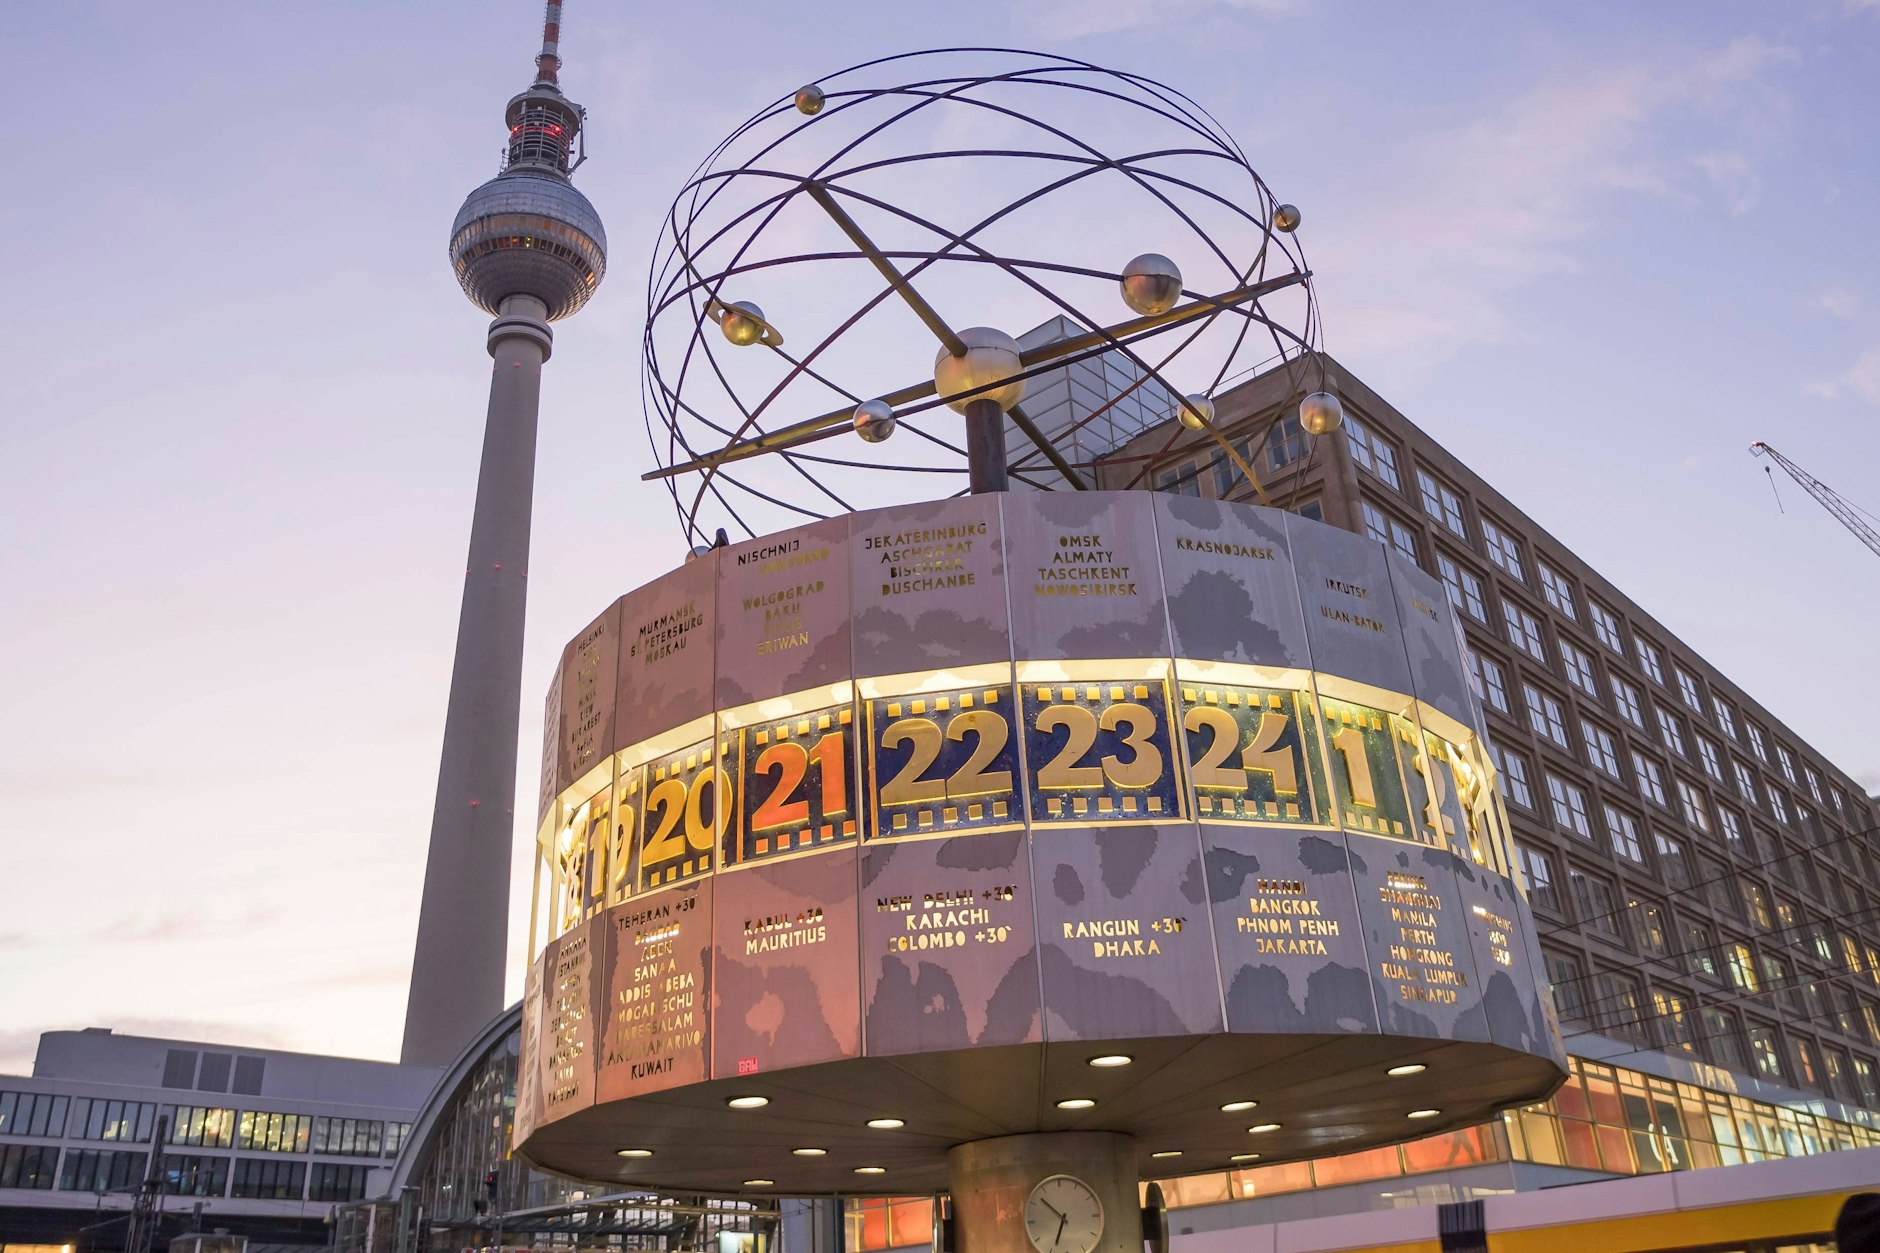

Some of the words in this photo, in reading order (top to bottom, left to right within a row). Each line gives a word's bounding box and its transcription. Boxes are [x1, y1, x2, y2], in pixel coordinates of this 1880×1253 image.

[865, 523, 987, 549] JEKATERINBURG
[1059, 535, 1102, 547] OMSK
[738, 540, 800, 566] NISCHNIJ
[881, 541, 973, 564] ASCHGABAT
[1053, 551, 1113, 563] ALMATY
[1176, 537, 1275, 561] KRASNOJARSK
[882, 573, 975, 596] DUSCHANBE
[1038, 567, 1130, 580] TASCHKENT
[743, 580, 824, 612] WOLGOGRAD
[1034, 583, 1138, 597] NOWOSIBIRSK
[1325, 578, 1368, 600] IRKUTSK
[639, 603, 696, 639] MURMANSK
[1321, 605, 1386, 633] ULAN-BATOR
[578, 623, 605, 653] HELSINKI
[644, 614, 703, 649] PETERSBURG
[645, 637, 688, 665] MOSKAU
[757, 632, 809, 656] ERIWAN
[880, 709, 1013, 806] 22
[1035, 703, 1163, 790] 23
[1184, 705, 1297, 795] 24
[1333, 727, 1376, 807] 1
[752, 731, 847, 831] 21
[642, 765, 733, 867] 20
[1257, 879, 1308, 896] HANOI
[1379, 887, 1442, 911] SHANGHAI
[877, 895, 912, 912] NEW
[924, 889, 974, 909] DELHI
[1249, 898, 1321, 916] BANGKOK
[619, 905, 670, 931] TEHERAN
[743, 913, 792, 936] KABUL
[906, 908, 990, 930] KARACHI
[1063, 919, 1140, 938] RANGUN
[1237, 917, 1293, 934] PHNOM
[1299, 919, 1339, 936] PENH
[1391, 907, 1438, 928] MANILA
[745, 925, 826, 955] MAURITIUS
[888, 930, 966, 952] COLOMBO
[1093, 939, 1161, 957] DHAKA
[1256, 938, 1328, 955] JAKARTA
[1400, 927, 1437, 946] PERTH
[1390, 945, 1454, 967] HONGKONG
[634, 957, 677, 982] SANAA
[1381, 962, 1421, 981] KUALA
[1424, 967, 1469, 987] LUMPUR
[619, 983, 651, 1005] ADDIS
[657, 971, 695, 993] ABEBA
[1400, 985, 1458, 1004] SINGAPUR
[617, 991, 694, 1022] MOGADSCHU
[631, 1057, 674, 1080] KUWAIT
